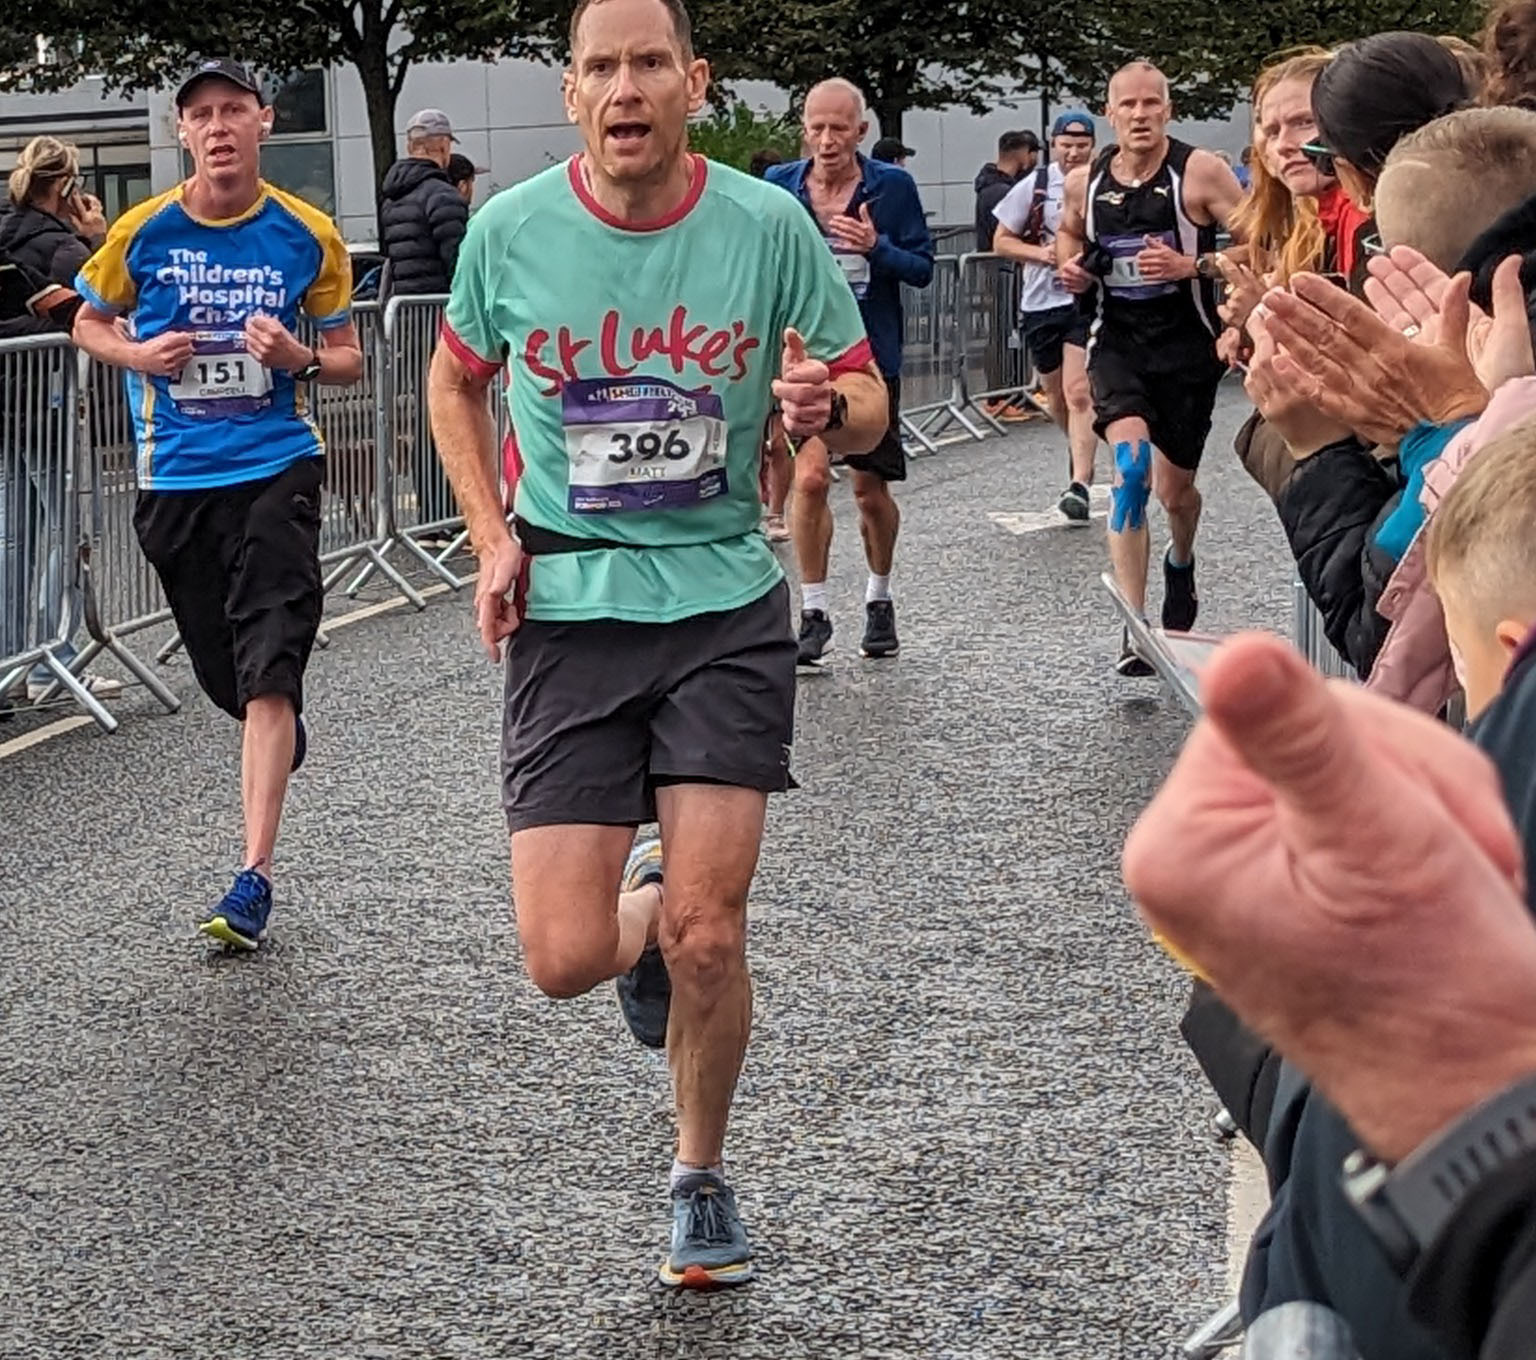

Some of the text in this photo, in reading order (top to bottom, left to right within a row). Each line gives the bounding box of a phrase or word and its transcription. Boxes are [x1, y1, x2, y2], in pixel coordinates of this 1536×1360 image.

[168, 248, 208, 264] The
[156, 264, 284, 285] Children's
[178, 284, 286, 308] Hospital
[524, 305, 760, 398] St Luke's
[197, 360, 246, 384] 151
[608, 429, 690, 463] 396
